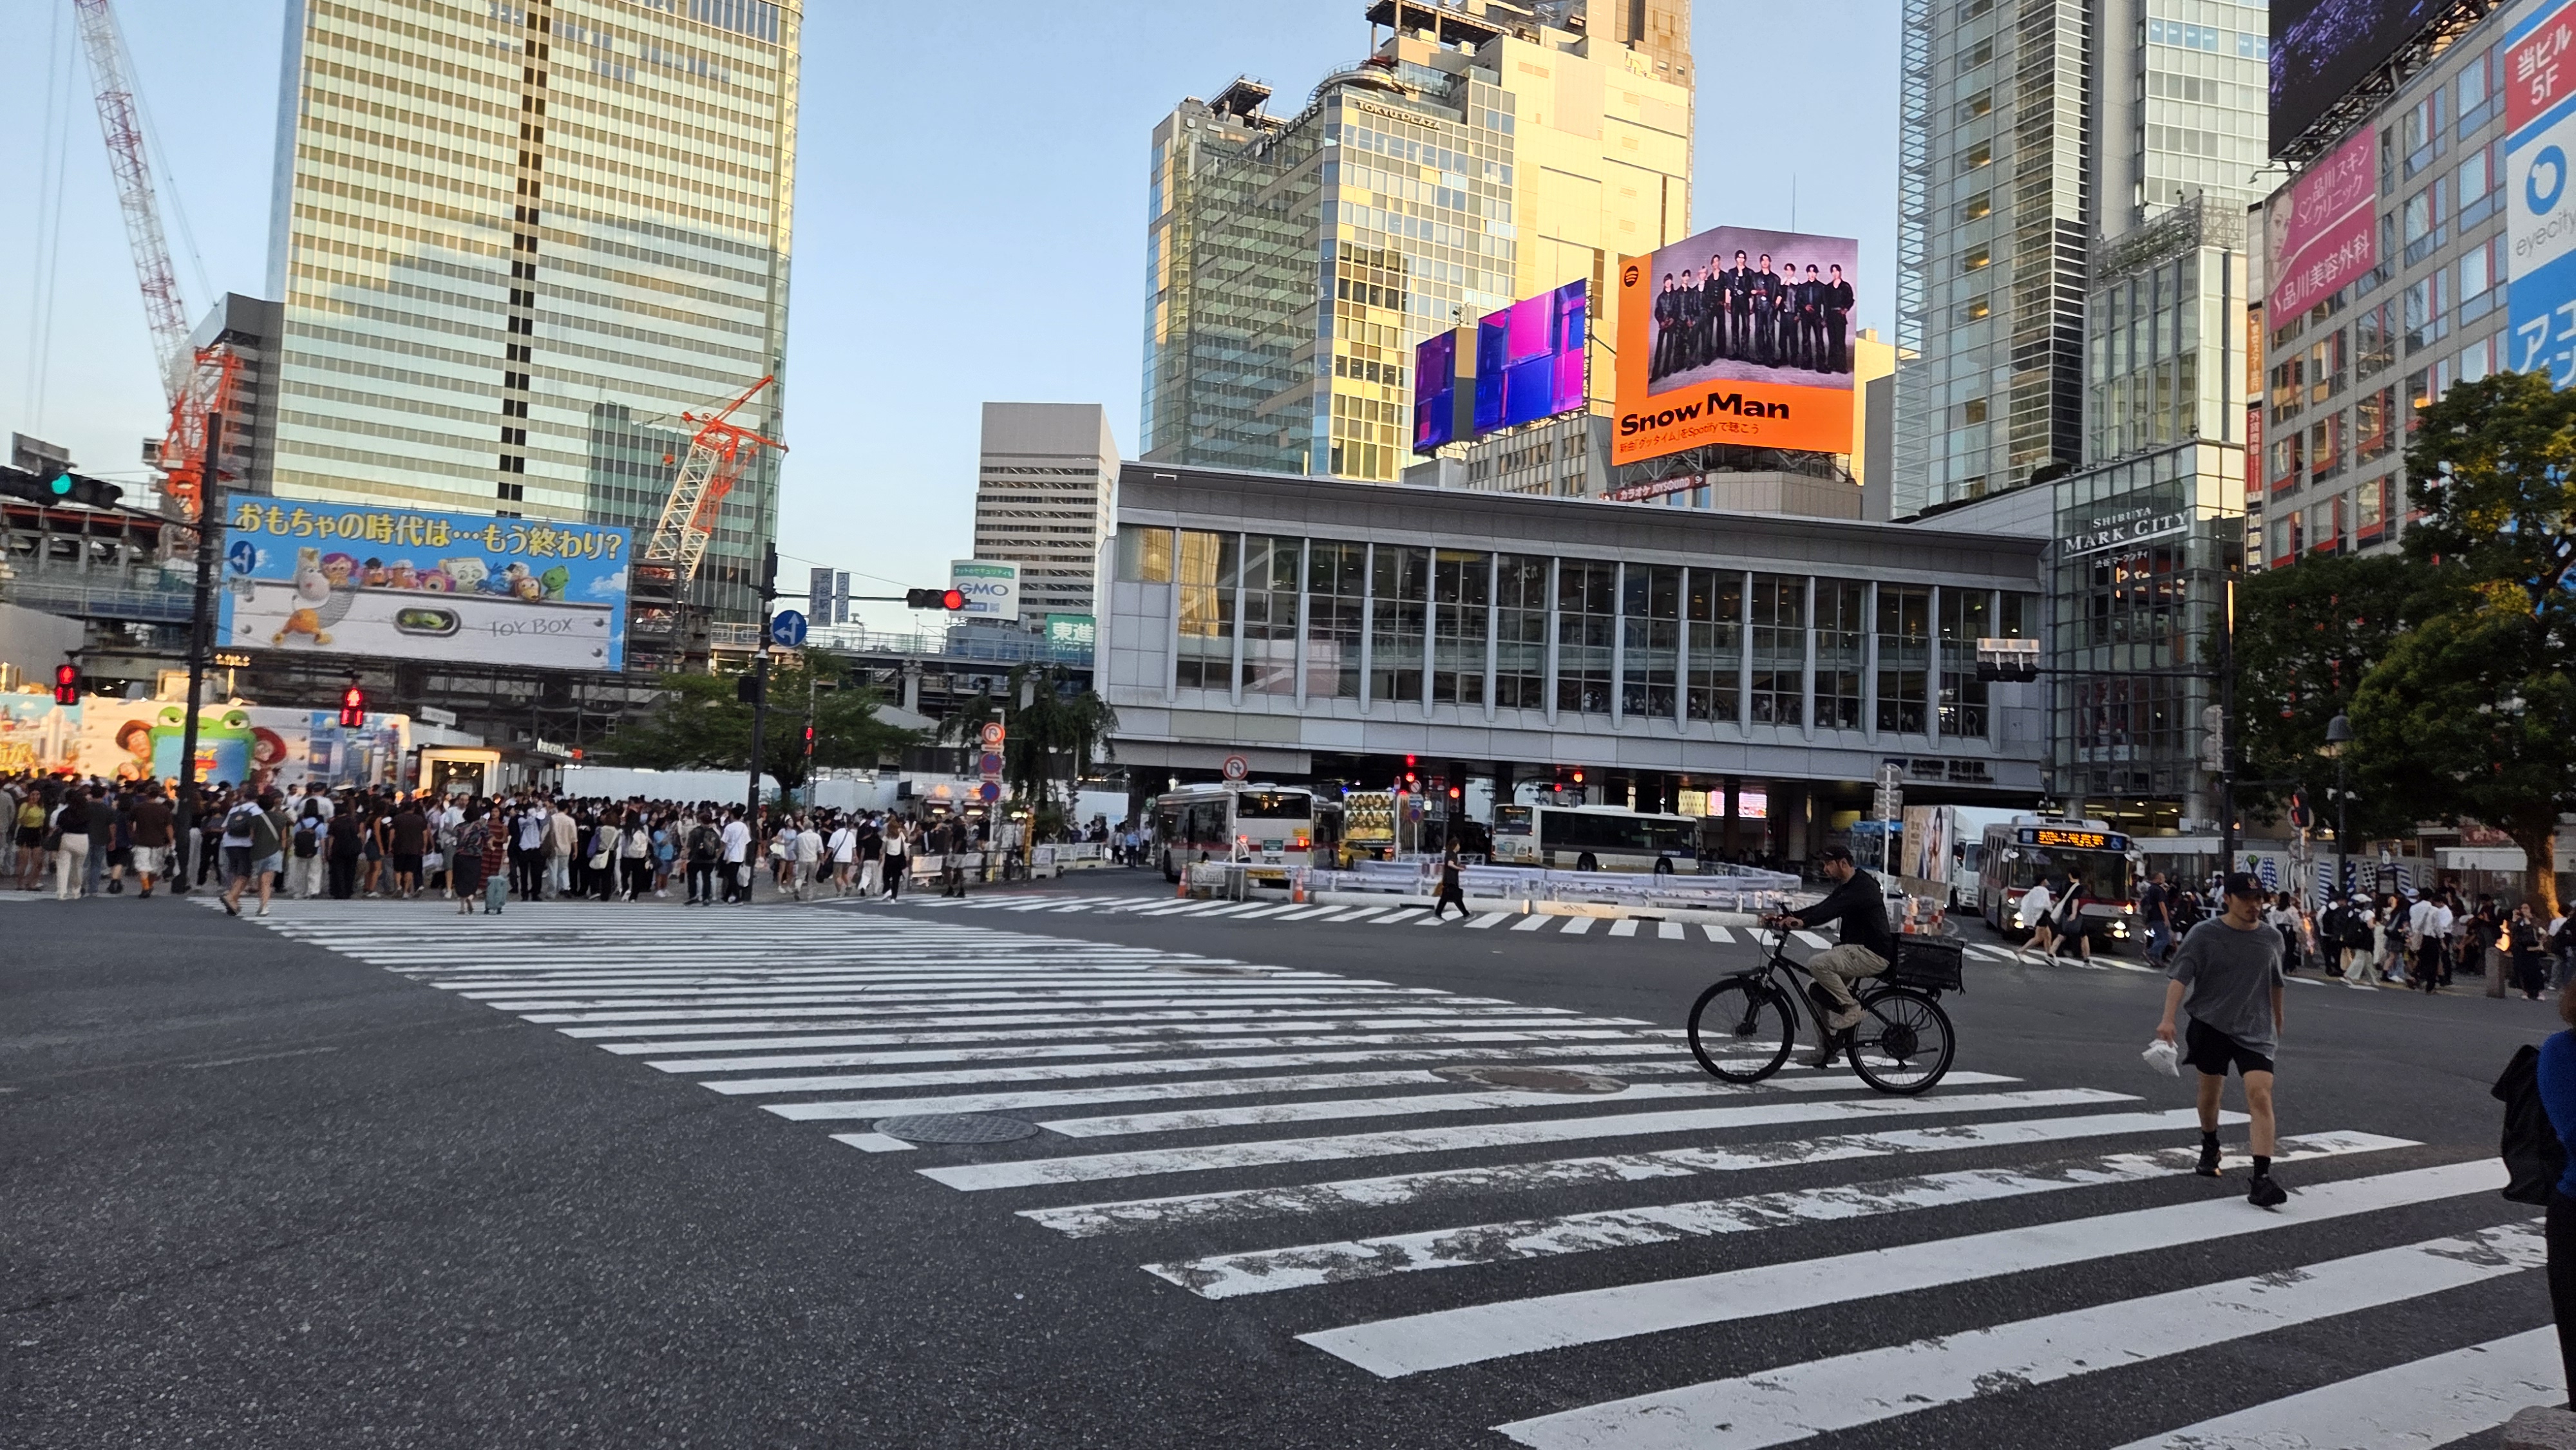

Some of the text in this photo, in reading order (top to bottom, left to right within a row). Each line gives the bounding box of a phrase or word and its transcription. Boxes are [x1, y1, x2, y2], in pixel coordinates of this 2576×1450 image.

[2517, 23, 2573, 83] 当ビル
[2532, 62, 2559, 105] 5F
[1357, 99, 1443, 130] TOKYU PLAZA
[2313, 145, 2369, 202] 品川スキン
[2313, 173, 2363, 226] クリニック
[2283, 229, 2371, 312] 品川美容外科
[1621, 392, 1790, 437] Snow Man
[1620, 486, 1651, 501] カラオケ
[1652, 477, 1690, 494] JOYSOUND
[2065, 509, 2189, 553] MARK CITY
[2093, 507, 2152, 529] SHIBUYA
[819, 572, 830, 623] 渋谷駅前
[957, 582, 1009, 596] GMO
[532, 617, 573, 634] BOX
[1052, 621, 1094, 643] 東進
